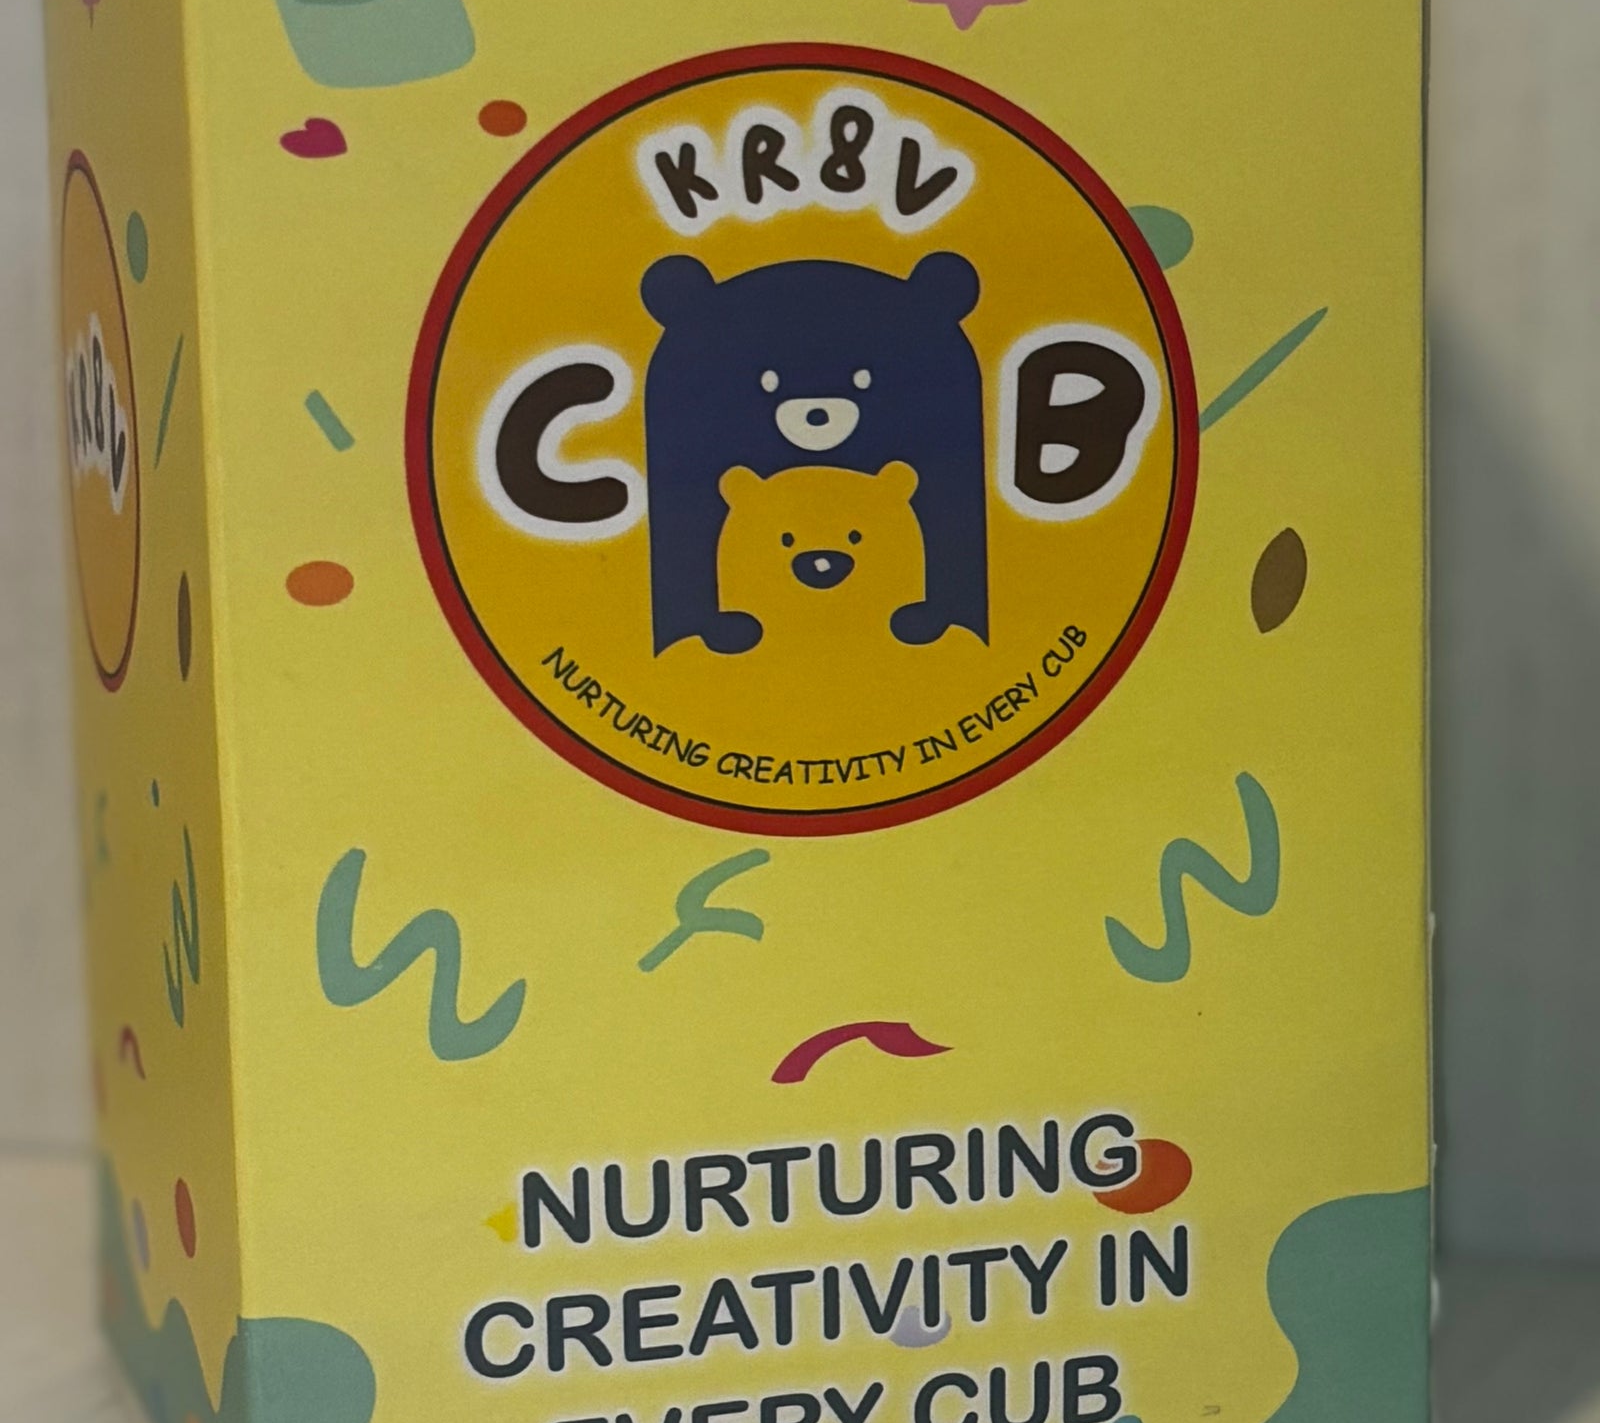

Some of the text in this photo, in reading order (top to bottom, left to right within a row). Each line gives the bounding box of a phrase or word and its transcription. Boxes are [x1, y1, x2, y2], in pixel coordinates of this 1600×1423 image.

[654, 105, 957, 217] KR8V
[542, 624, 1088, 784] NURTURING CREATIVITY IN EVERY CUB
[521, 1113, 1138, 1249] NURTURING
[464, 1225, 1190, 1379] CREATIVITY IN
